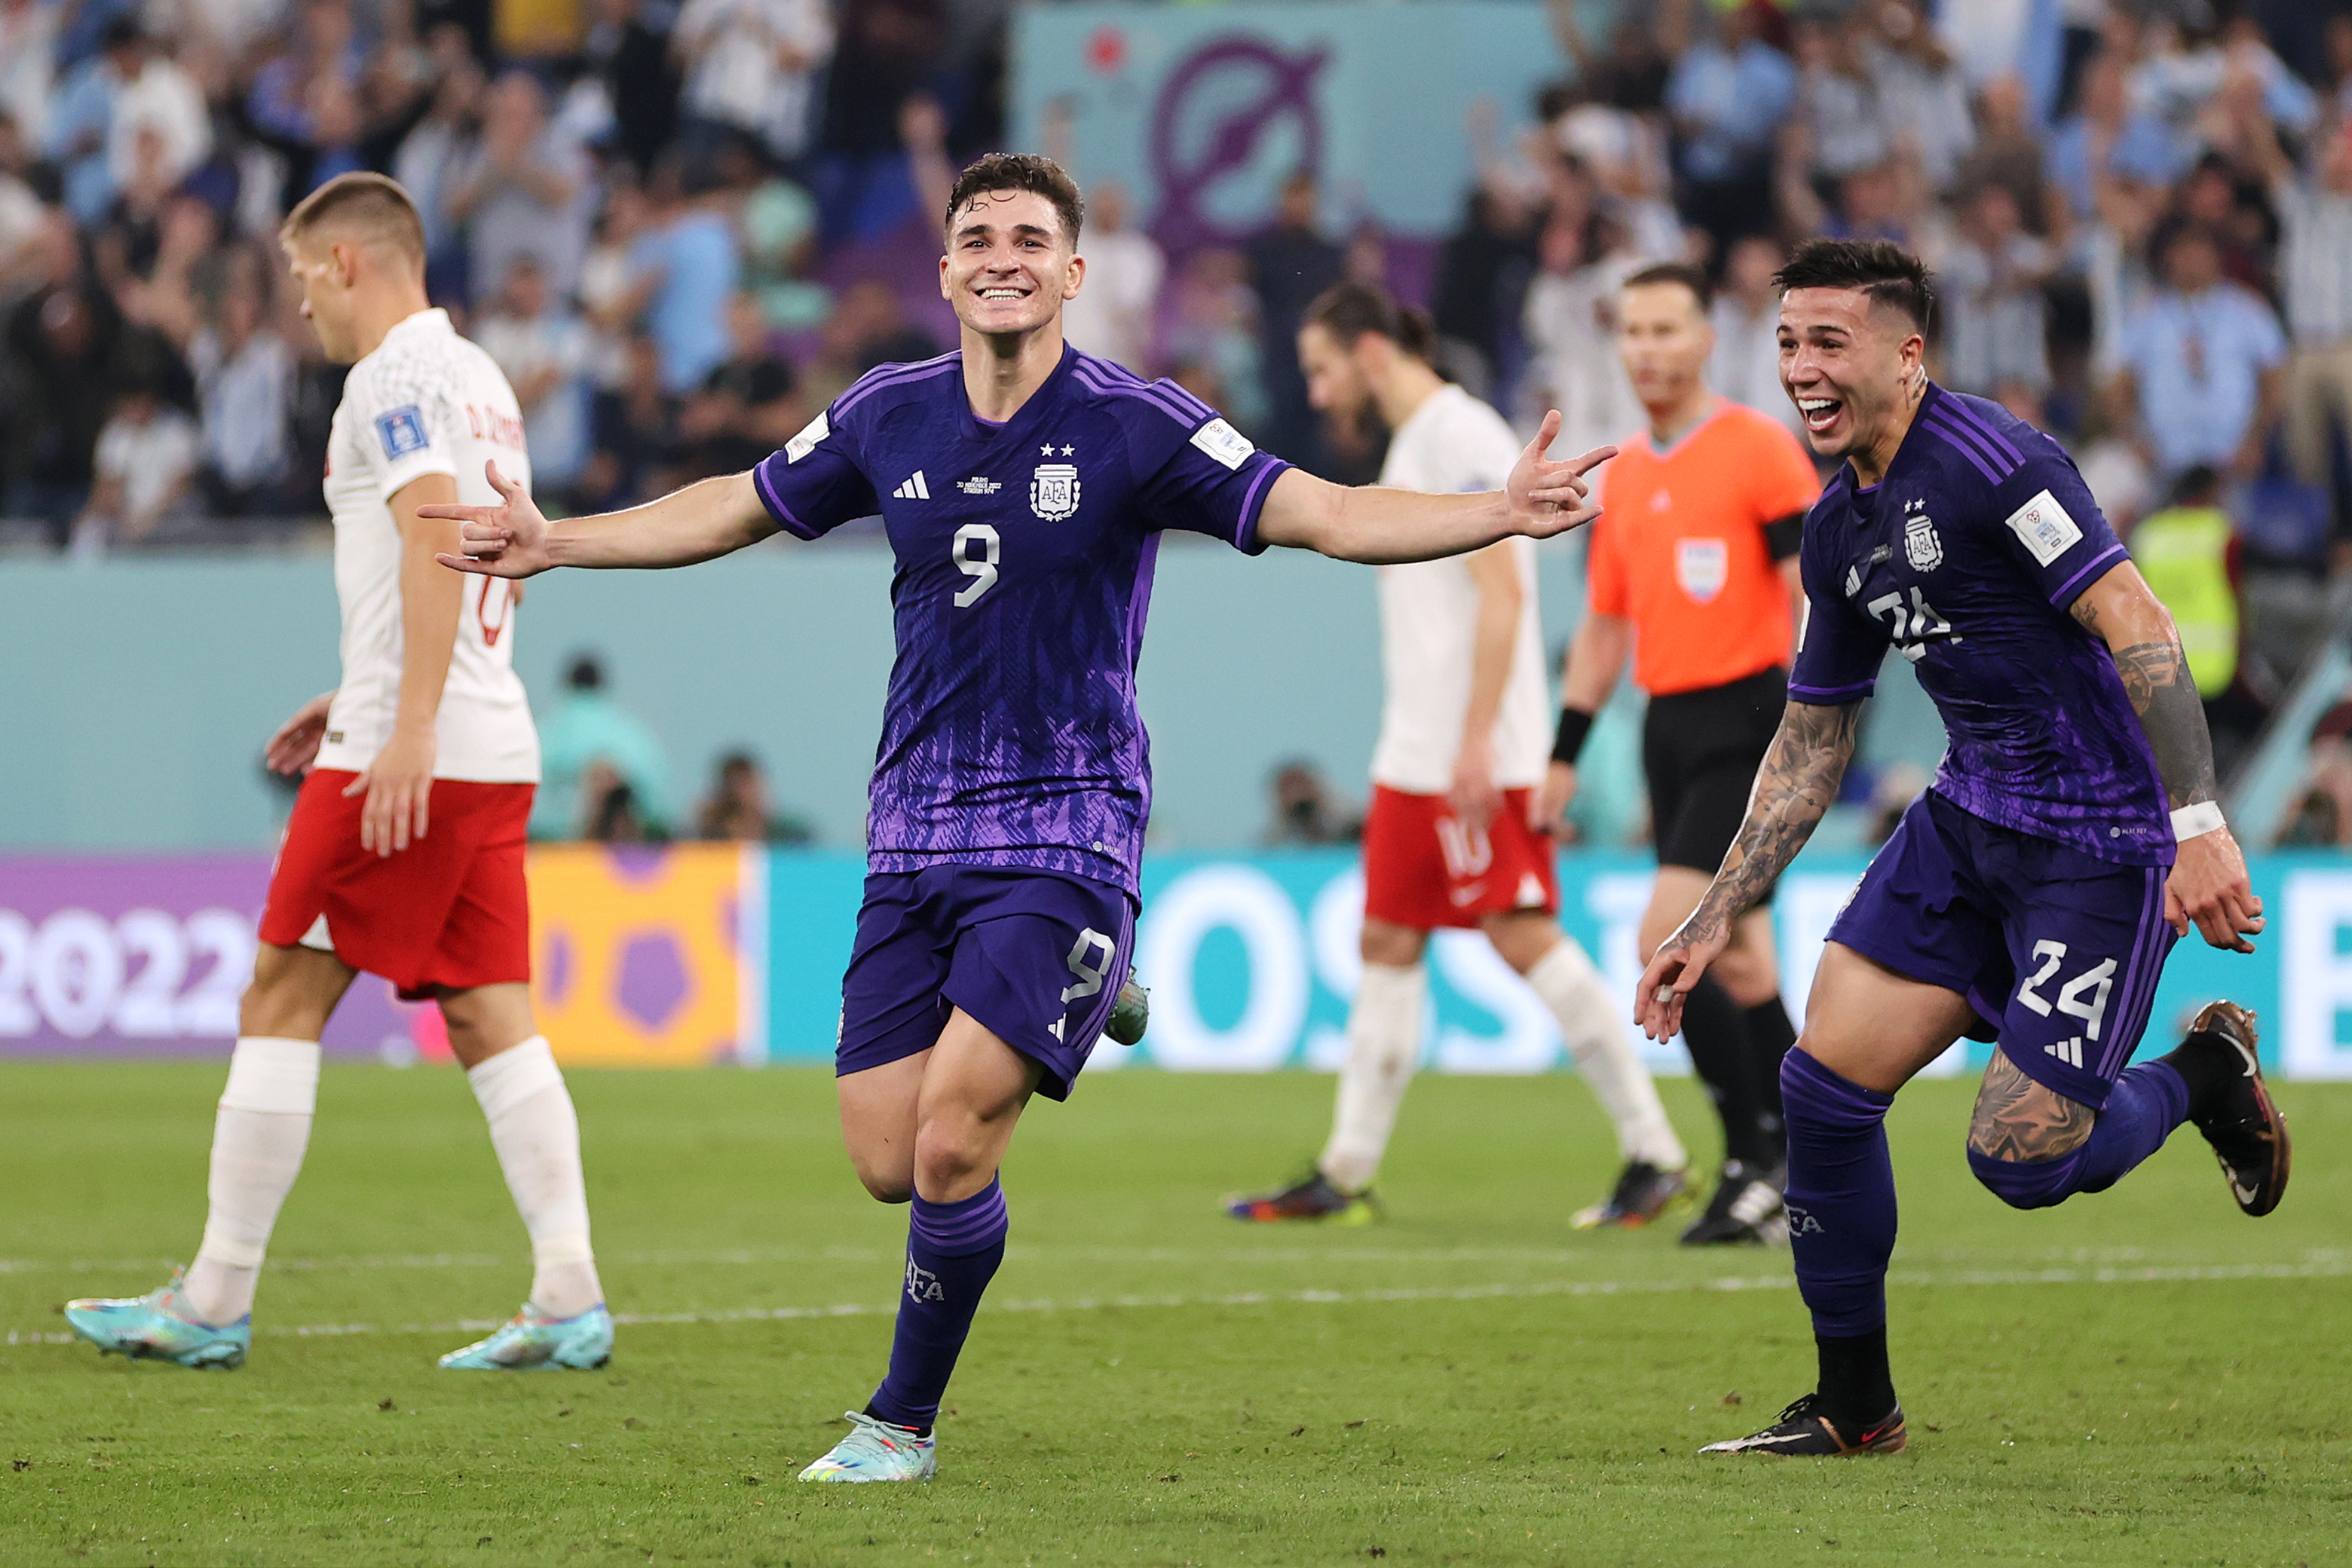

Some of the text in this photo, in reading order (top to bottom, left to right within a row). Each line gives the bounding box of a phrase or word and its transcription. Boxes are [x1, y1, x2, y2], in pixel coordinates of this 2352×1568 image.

[1041, 479, 1068, 504] AFA
[952, 523, 1000, 608] 9
[0, 908, 256, 1039] 2022
[1060, 926, 1116, 1005] 9
[2017, 939, 2118, 1042] 24
[1783, 1203, 1825, 1238] FA
